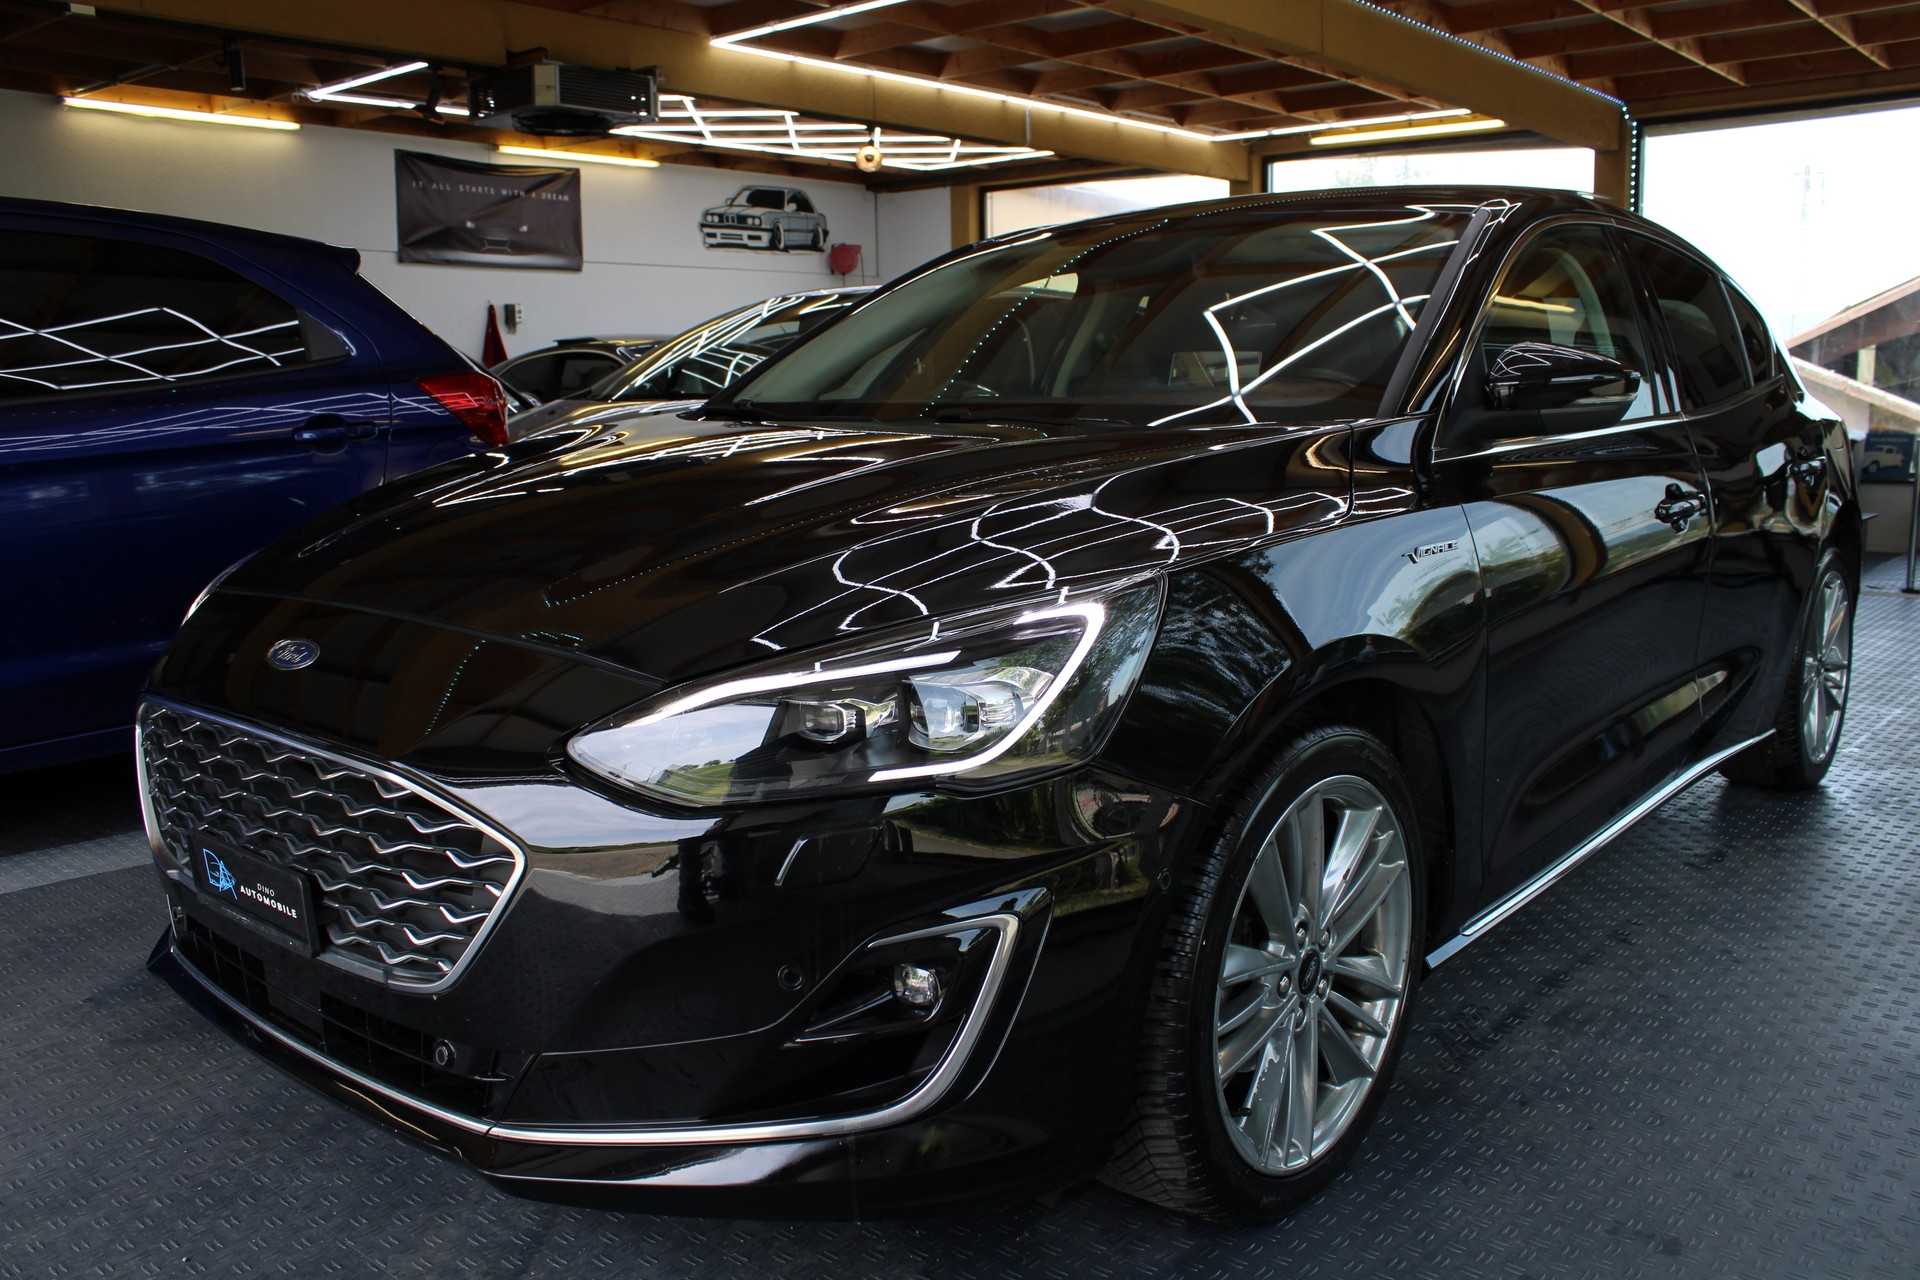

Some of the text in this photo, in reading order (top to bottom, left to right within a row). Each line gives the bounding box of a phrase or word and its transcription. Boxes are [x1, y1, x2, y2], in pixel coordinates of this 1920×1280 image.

[412, 180, 424, 189] IT
[431, 182, 451, 192] ALL
[459, 184, 495, 196] STARTS
[501, 188, 526, 198] WITH
[541, 192, 570, 202] DREAM
[256, 883, 275, 897] DINO
[240, 885, 298, 919] AUTOMOBILE
